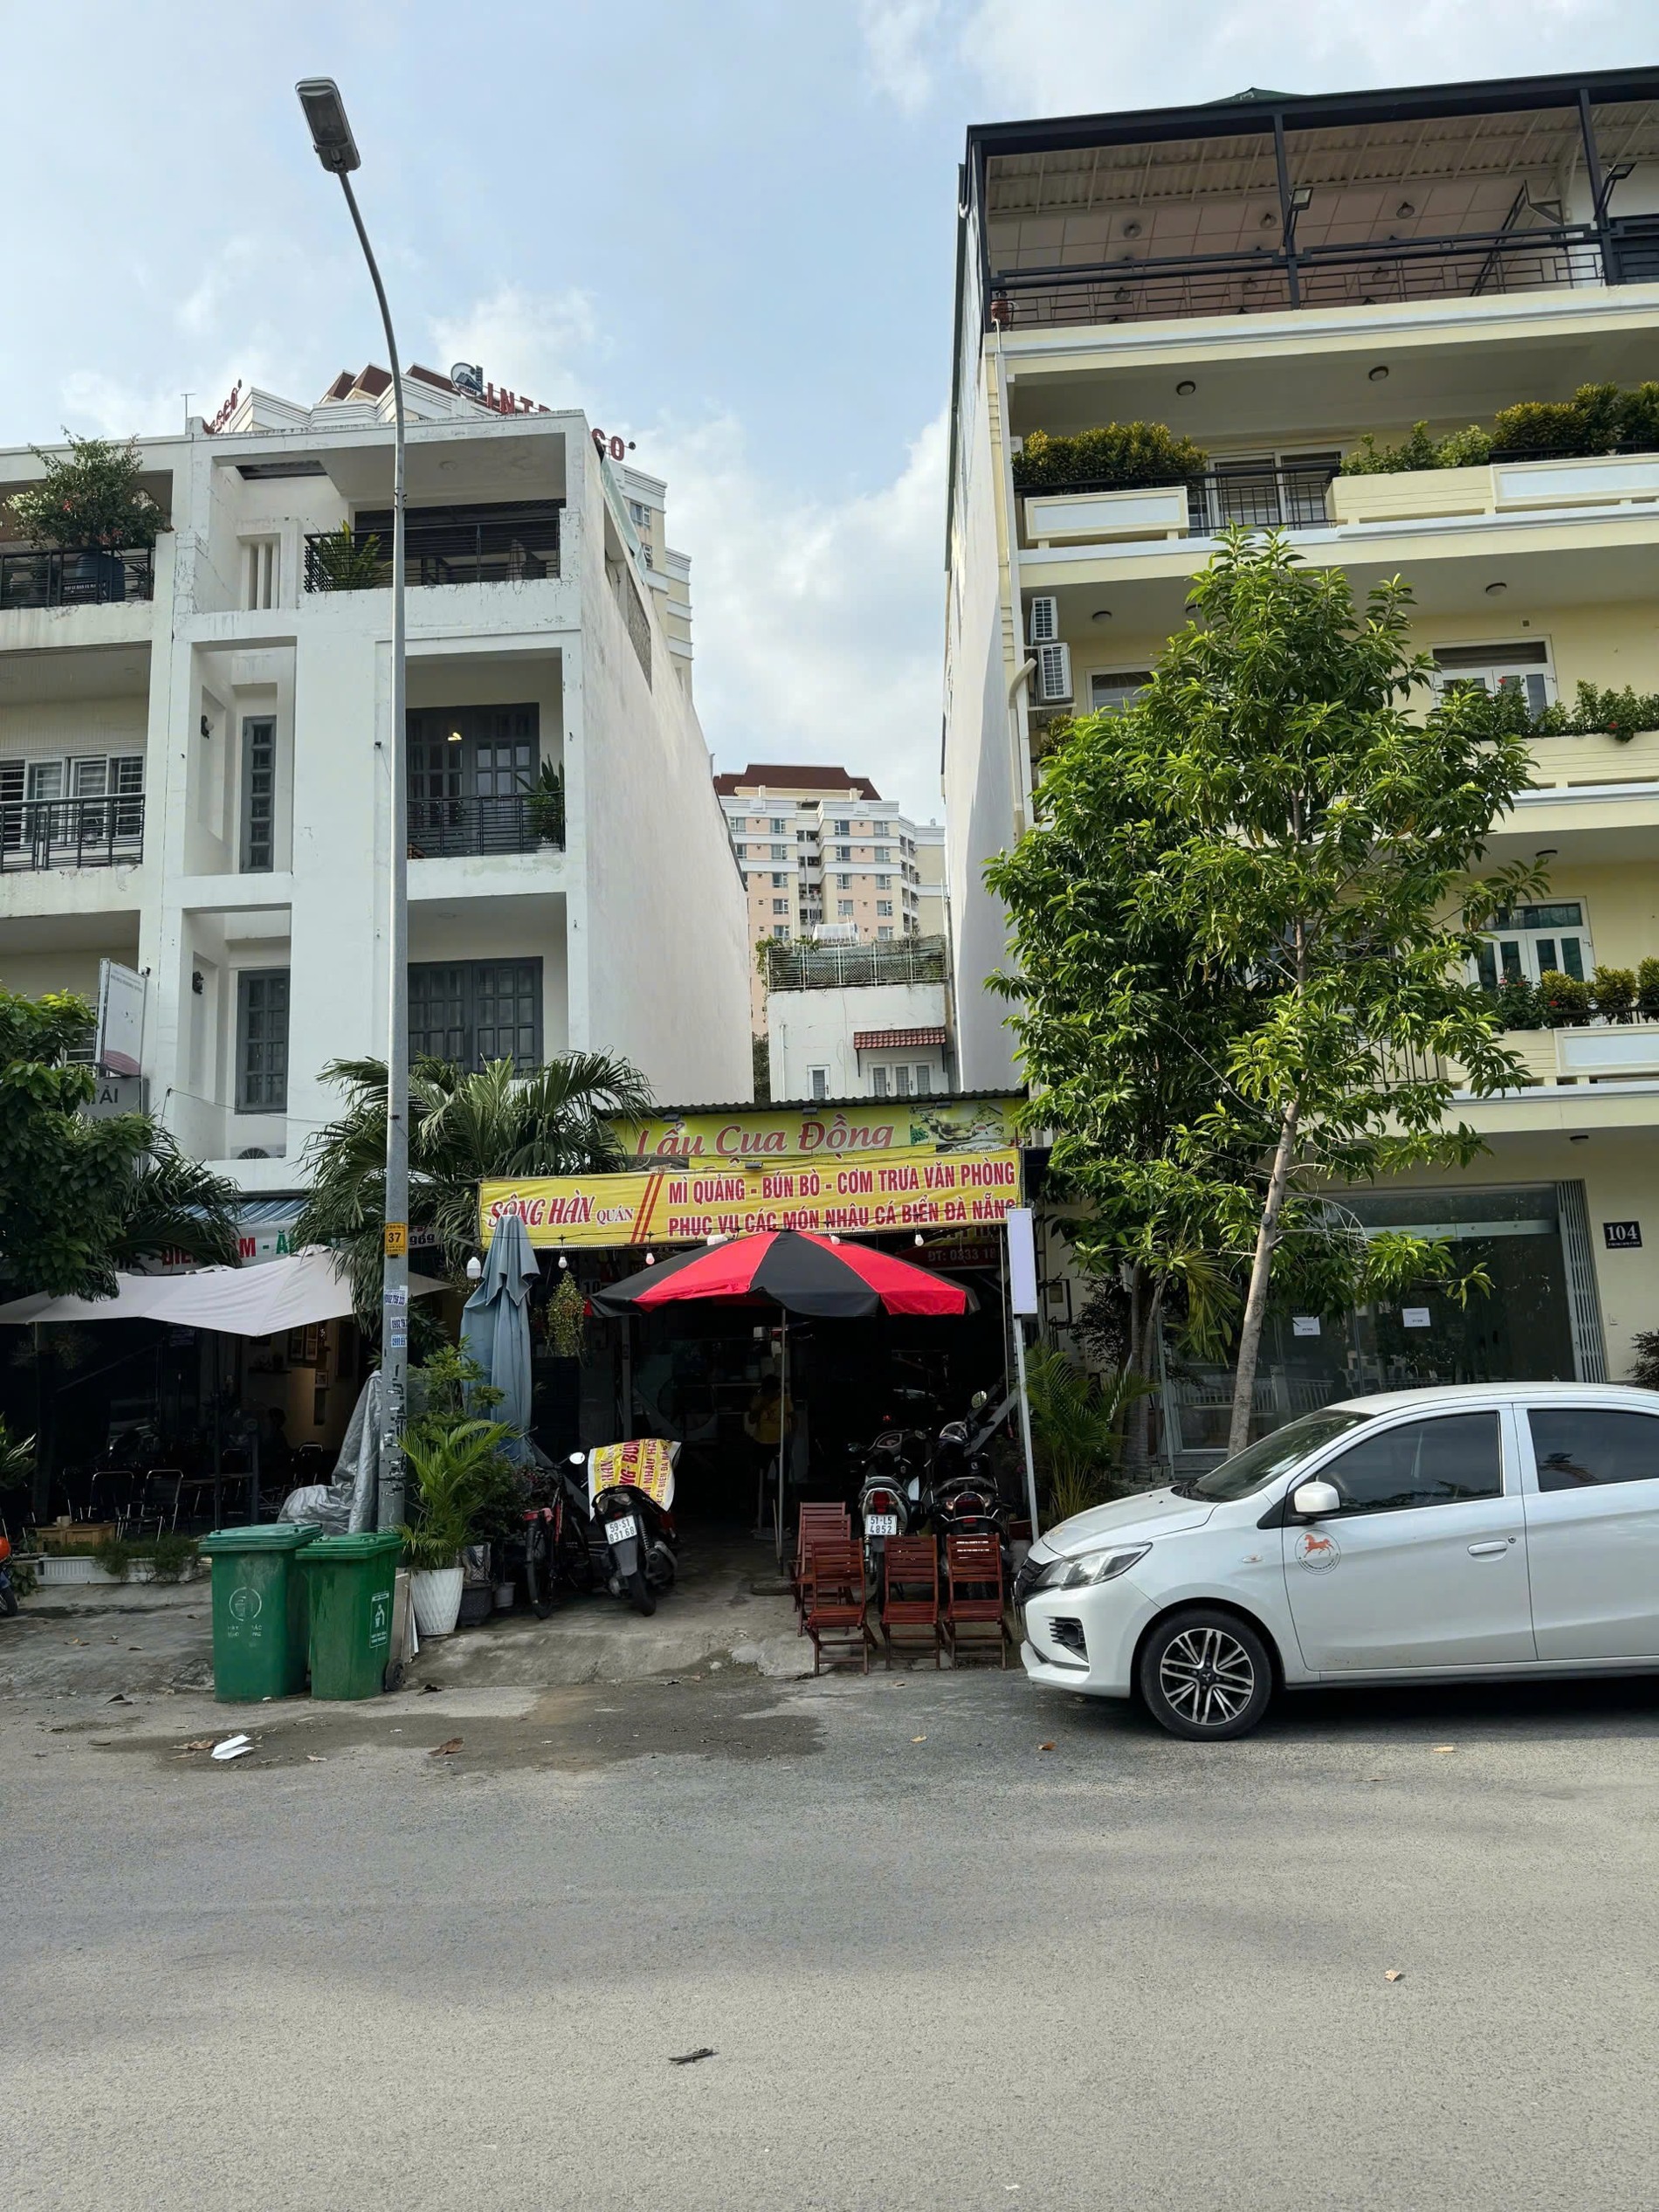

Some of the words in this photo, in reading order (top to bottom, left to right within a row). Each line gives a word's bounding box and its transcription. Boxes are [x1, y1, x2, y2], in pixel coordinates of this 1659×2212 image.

[716, 1125, 788, 1154] Cua
[798, 1113, 895, 1151] Đồng
[668, 1175, 688, 1204] MÌ
[693, 1173, 746, 1205] QUẢNG
[762, 1171, 794, 1199] BÚN
[799, 1168, 821, 1197] BÒ
[837, 1168, 872, 1195] CƠM
[878, 1165, 919, 1192] TRƯA
[924, 1161, 955, 1189] VĂN
[960, 1157, 1015, 1187] PHÒNG
[547, 1189, 595, 1225] HÀN
[596, 1204, 635, 1224] QUÁN
[745, 1208, 777, 1233] CÁC
[782, 1205, 819, 1230] MÓN
[874, 1200, 897, 1225] CÁ
[901, 1194, 939, 1223] BIỂN
[944, 1196, 967, 1222] ĐÀ
[388, 1231, 402, 1244] 37
[1607, 1224, 1638, 1241] 104
[870, 1525, 892, 1534] 4852
